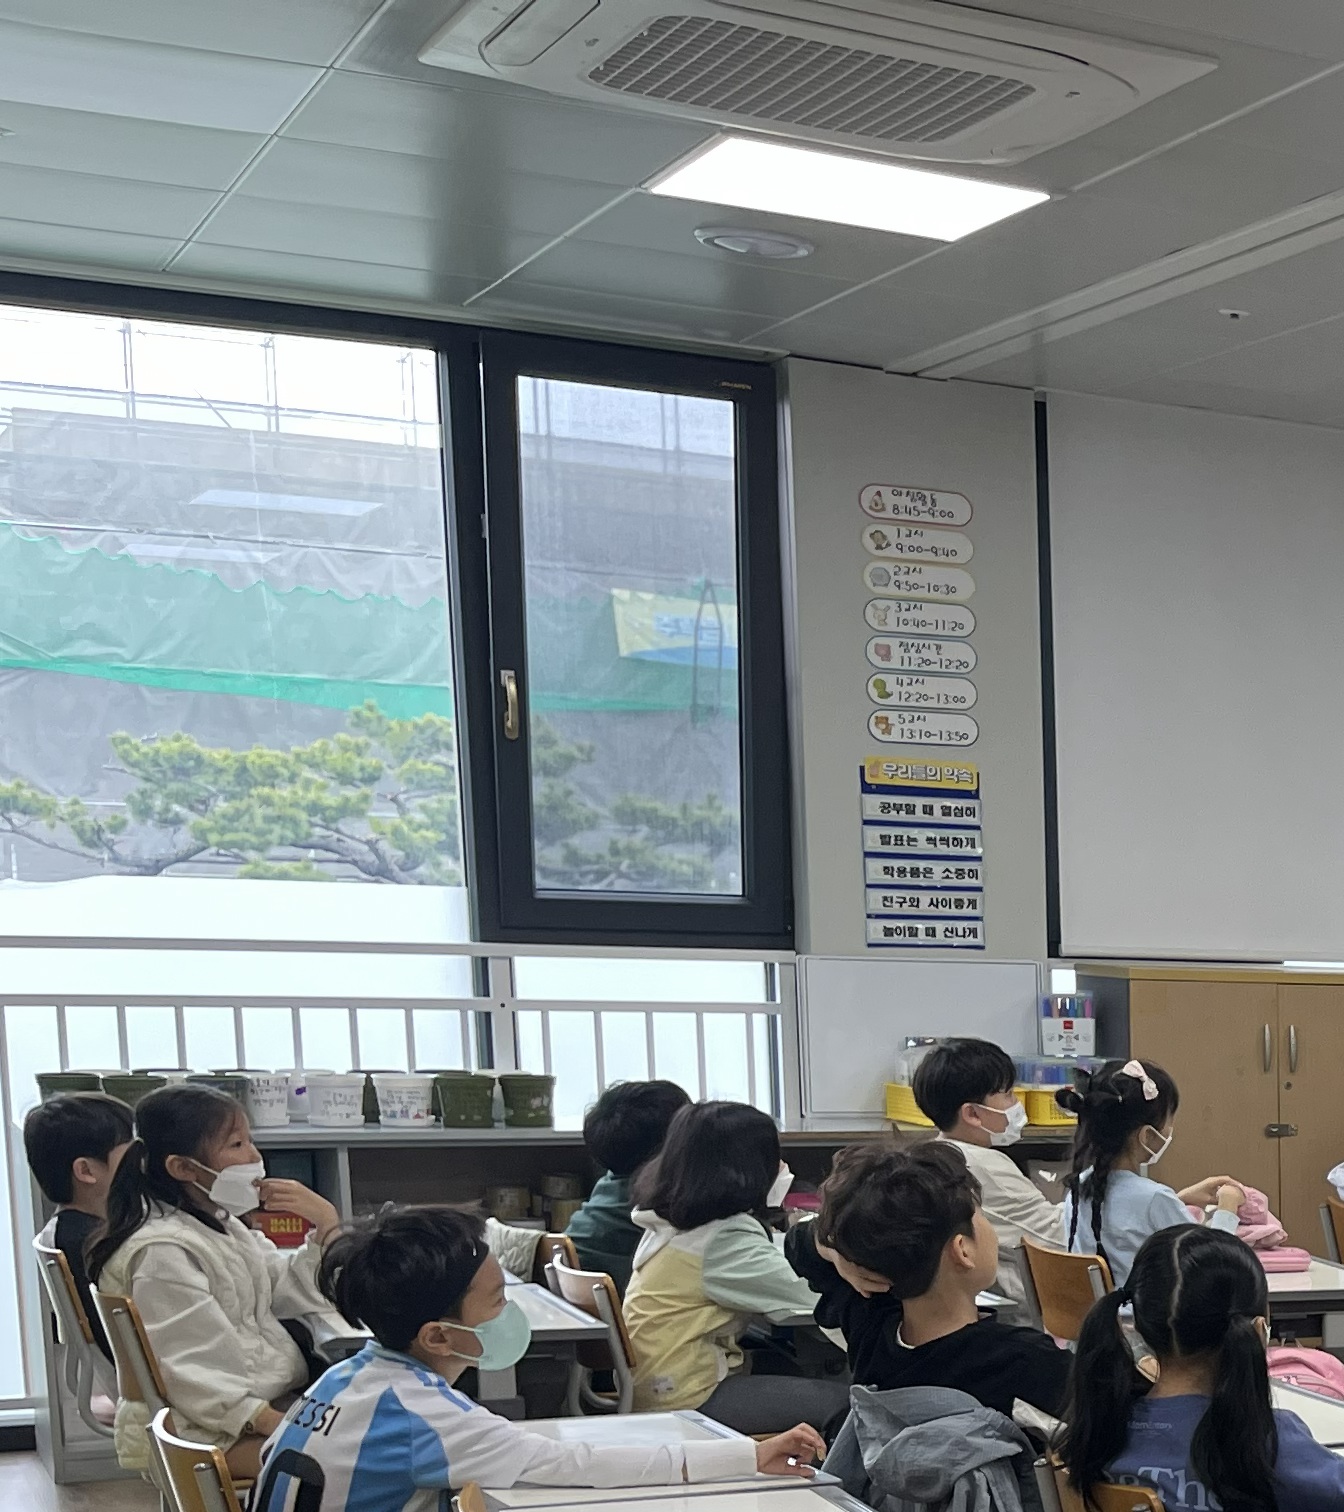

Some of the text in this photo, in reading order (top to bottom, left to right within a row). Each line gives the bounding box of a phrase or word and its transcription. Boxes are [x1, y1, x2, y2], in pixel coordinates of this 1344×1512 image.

[892, 504, 955, 519] 8:45-9:00
[895, 542, 958, 557] 9:00-9:40
[893, 579, 957, 595] 9:50-10:30
[896, 616, 965, 631] 10:40-11:20
[900, 655, 970, 669] 11:20-12:20
[898, 690, 967, 704] 12:20-13:00
[900, 727, 970, 741] 13:10-13:50
[882, 762, 974, 784] 우리들의 약속
[878, 801, 977, 818] 공부할 때 열심히
[879, 833, 977, 850] 발표는 씩씩하게
[882, 865, 979, 882] 학용품은 소중히
[881, 895, 978, 911] 친구와 사이좋게
[882, 925, 979, 940] 놀이할 때 신나게
[290, 1396, 341, 1436] ESSI
